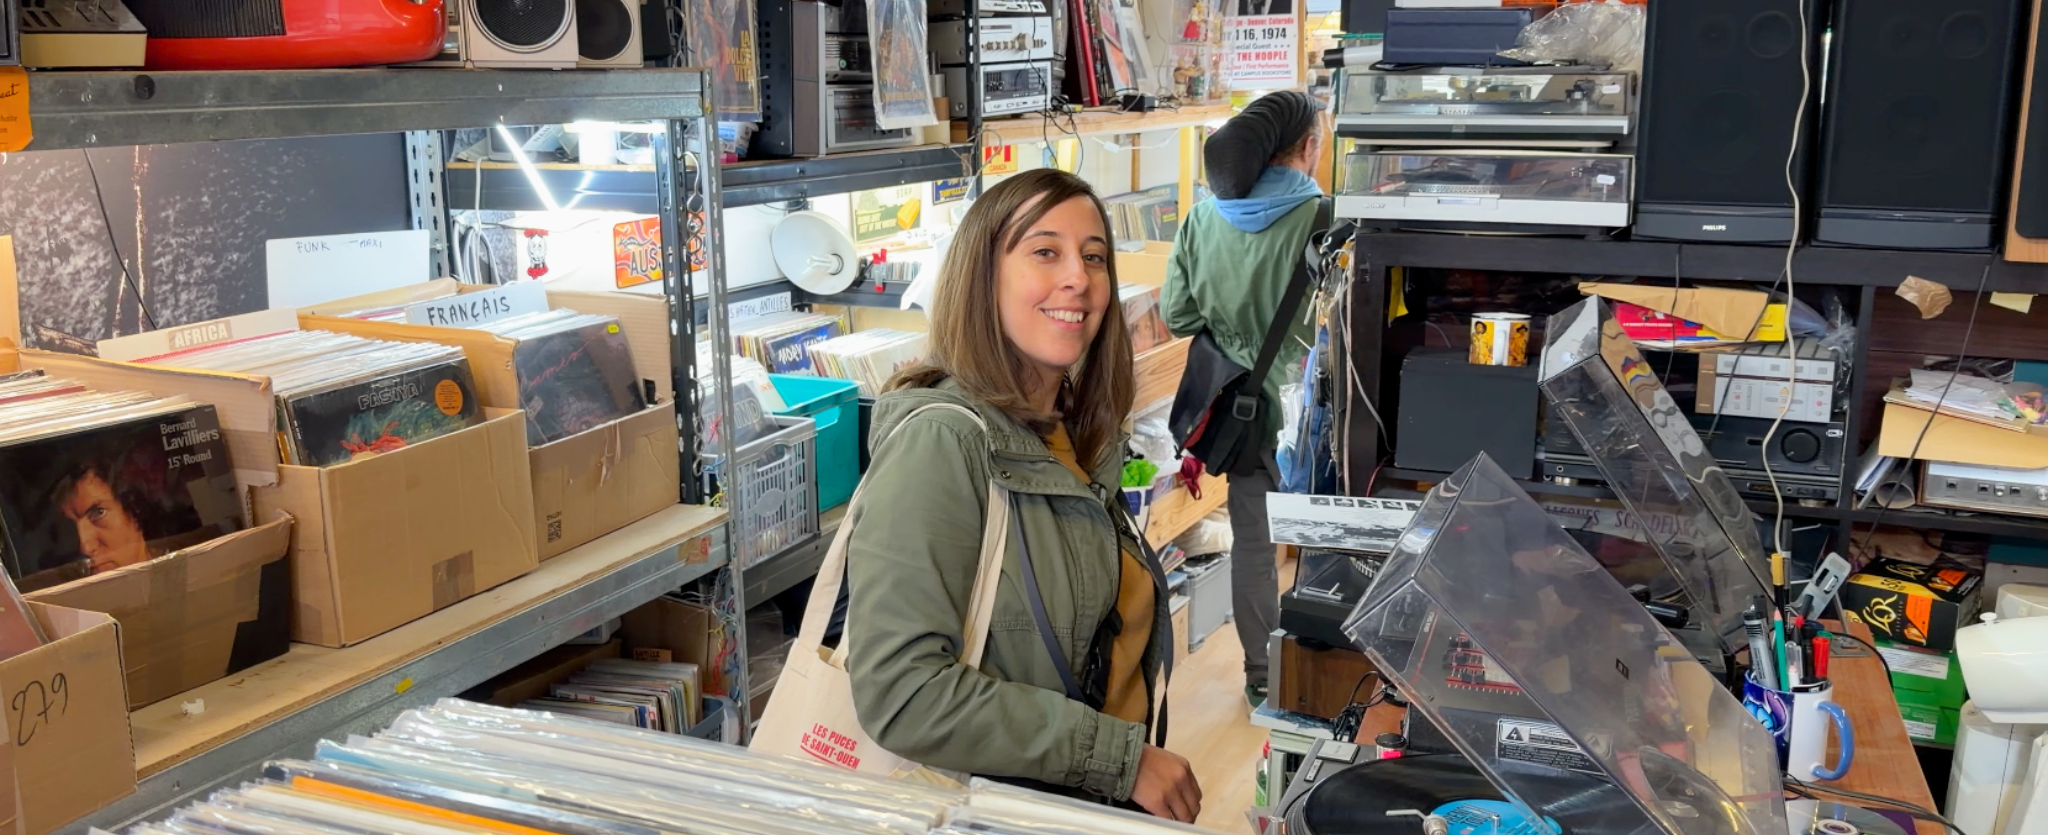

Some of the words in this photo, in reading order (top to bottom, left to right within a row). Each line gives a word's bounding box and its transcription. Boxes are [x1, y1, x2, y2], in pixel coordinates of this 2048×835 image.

[1243, 28, 1259, 41] 16,
[1262, 27, 1287, 40] 1974
[1237, 52, 1252, 62] THE
[1255, 51, 1288, 61] HOOPLE
[295, 241, 331, 253] FUNK
[427, 291, 510, 326] FRANÇAIS
[174, 323, 228, 348] AFRICA
[160, 417, 197, 434] Bernard
[162, 428, 220, 450] Lavilliers
[183, 449, 212, 465] Round
[11, 672, 69, 747] 279
[812, 722, 829, 739] LES
[828, 730, 857, 752] PUCES
[801, 732, 811, 746] DE
[810, 738, 861, 770] SAINT-OUEN
